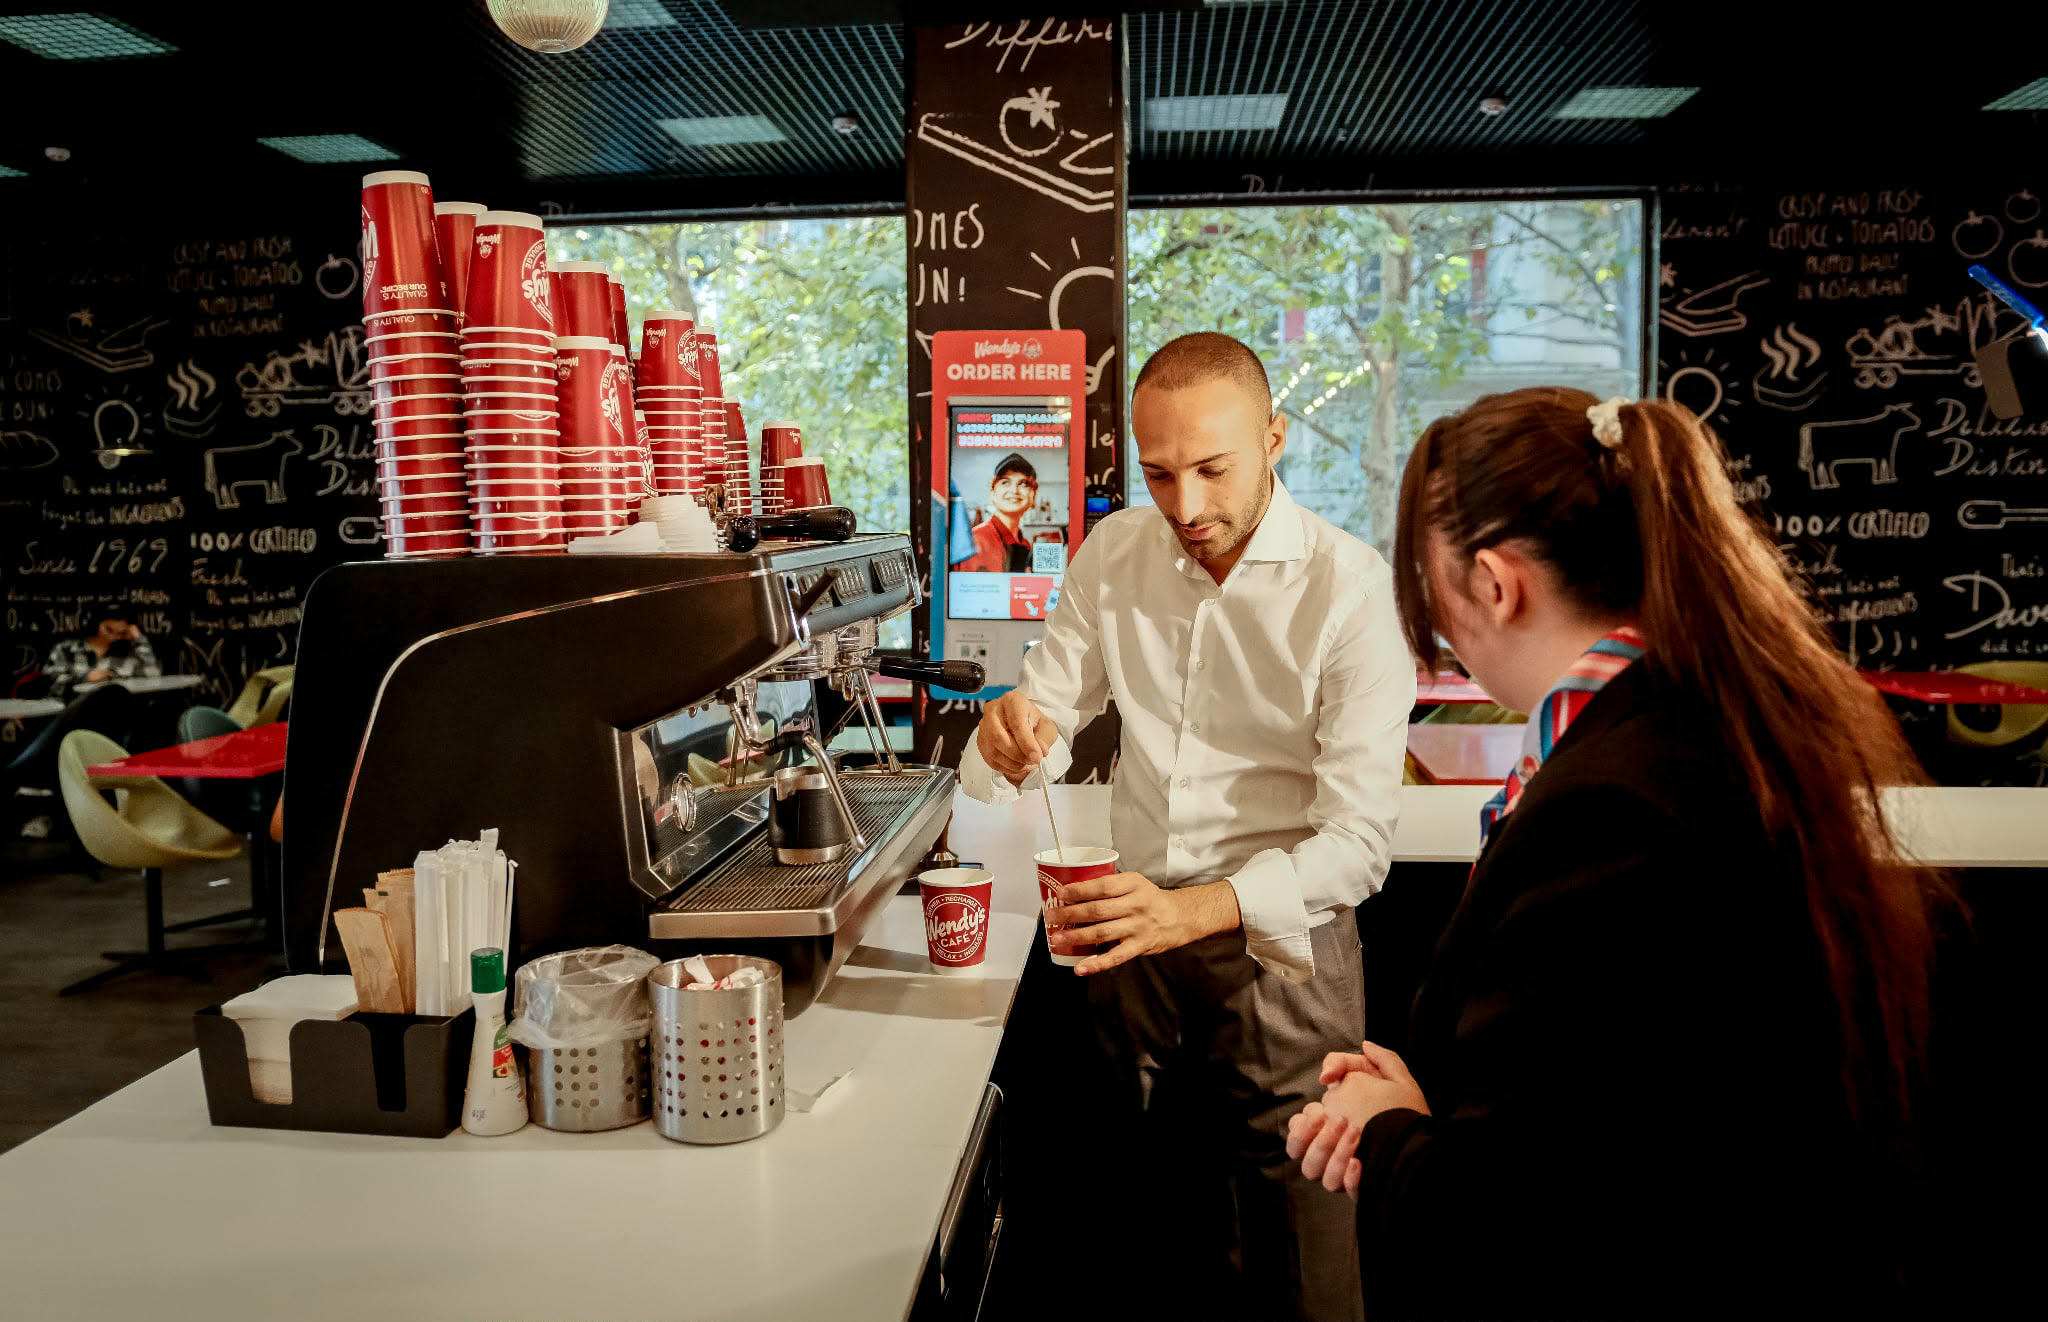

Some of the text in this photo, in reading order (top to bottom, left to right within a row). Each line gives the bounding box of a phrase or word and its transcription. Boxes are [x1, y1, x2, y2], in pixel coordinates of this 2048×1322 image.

[974, 338, 1021, 359] Wendy's
[946, 363, 1072, 382] ORDER HERE
[190, 532, 243, 552] 100%
[87, 537, 169, 575] 1969
[944, 895, 978, 909] RECHARGE
[925, 906, 986, 942] Wendy's
[940, 931, 971, 948] CAFÉ
